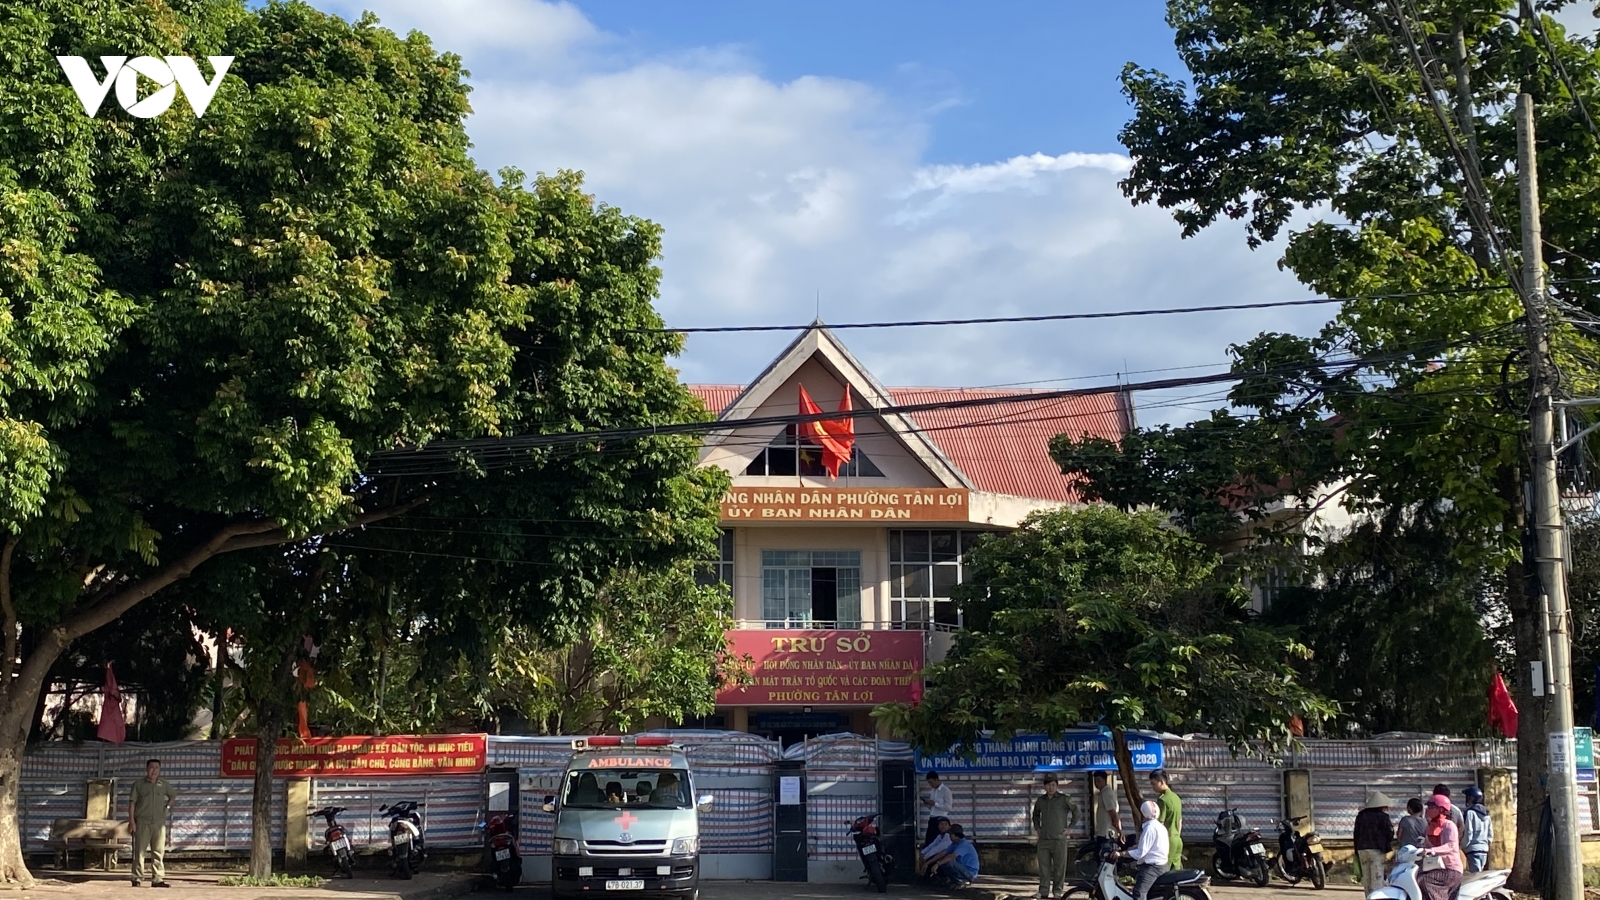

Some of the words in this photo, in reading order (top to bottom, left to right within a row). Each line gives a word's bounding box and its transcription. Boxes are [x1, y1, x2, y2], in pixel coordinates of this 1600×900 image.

[753, 490, 795, 504] NHÂN
[800, 490, 832, 504] DÂN
[837, 490, 899, 505] PHƯỜNG
[903, 491, 934, 505] TÂN
[939, 492, 962, 508] LỢI
[728, 505, 754, 517] ỦY
[762, 508, 802, 518] BAN
[809, 507, 863, 518] NHÂN
[870, 507, 911, 518] DÂN
[771, 637, 826, 655] TRỤ
[836, 632, 871, 653] SỞ
[763, 659, 778, 670] HỘI
[780, 656, 800, 670] ĐỒNG
[802, 659, 824, 670] NHÂN
[826, 659, 842, 670] DÂN
[861, 660, 877, 670] BAN
[879, 658, 901, 670] NHÂN
[903, 659, 914, 670] DÂ
[782, 675, 801, 687] TRẬN
[817, 672, 838, 688] QUỐC
[840, 675, 850, 686] VÀ
[852, 675, 868, 686] CÁC
[871, 675, 891, 686] ĐOÀN
[768, 688, 820, 701] PHƯỜNG
[825, 690, 849, 701] TÂN
[853, 690, 873, 702] LỢI
[234, 744, 254, 755] PHÁT
[274, 743, 290, 755] SỨC
[291, 743, 315, 756] MẠNH
[375, 741, 389, 753] KẾT
[391, 742, 407, 753] DÂN
[428, 742, 436, 753] VÌ
[438, 742, 455, 755] MỤC
[457, 741, 474, 752] TIÊU
[1015, 739, 1039, 753] HÀNH
[1041, 738, 1065, 753] ĐỘNG
[1067, 738, 1076, 752] VÌ
[1078, 738, 1099, 752] BÌNH
[1127, 738, 1146, 751] GIỚI
[323, 757, 334, 770] XÃ
[351, 757, 368, 768] DÂN
[389, 756, 411, 768] CÔNG
[437, 756, 454, 768] VĂN
[588, 757, 671, 768] AMBULANCE
[1002, 756, 1019, 768] BẠO
[1022, 755, 1038, 768] LỰC
[1041, 755, 1063, 767] TRÊN
[1065, 755, 1077, 766] CƠ
[1078, 752, 1091, 766] SỞ
[1093, 753, 1114, 765] GIỚI
[1136, 754, 1157, 765] 2020
